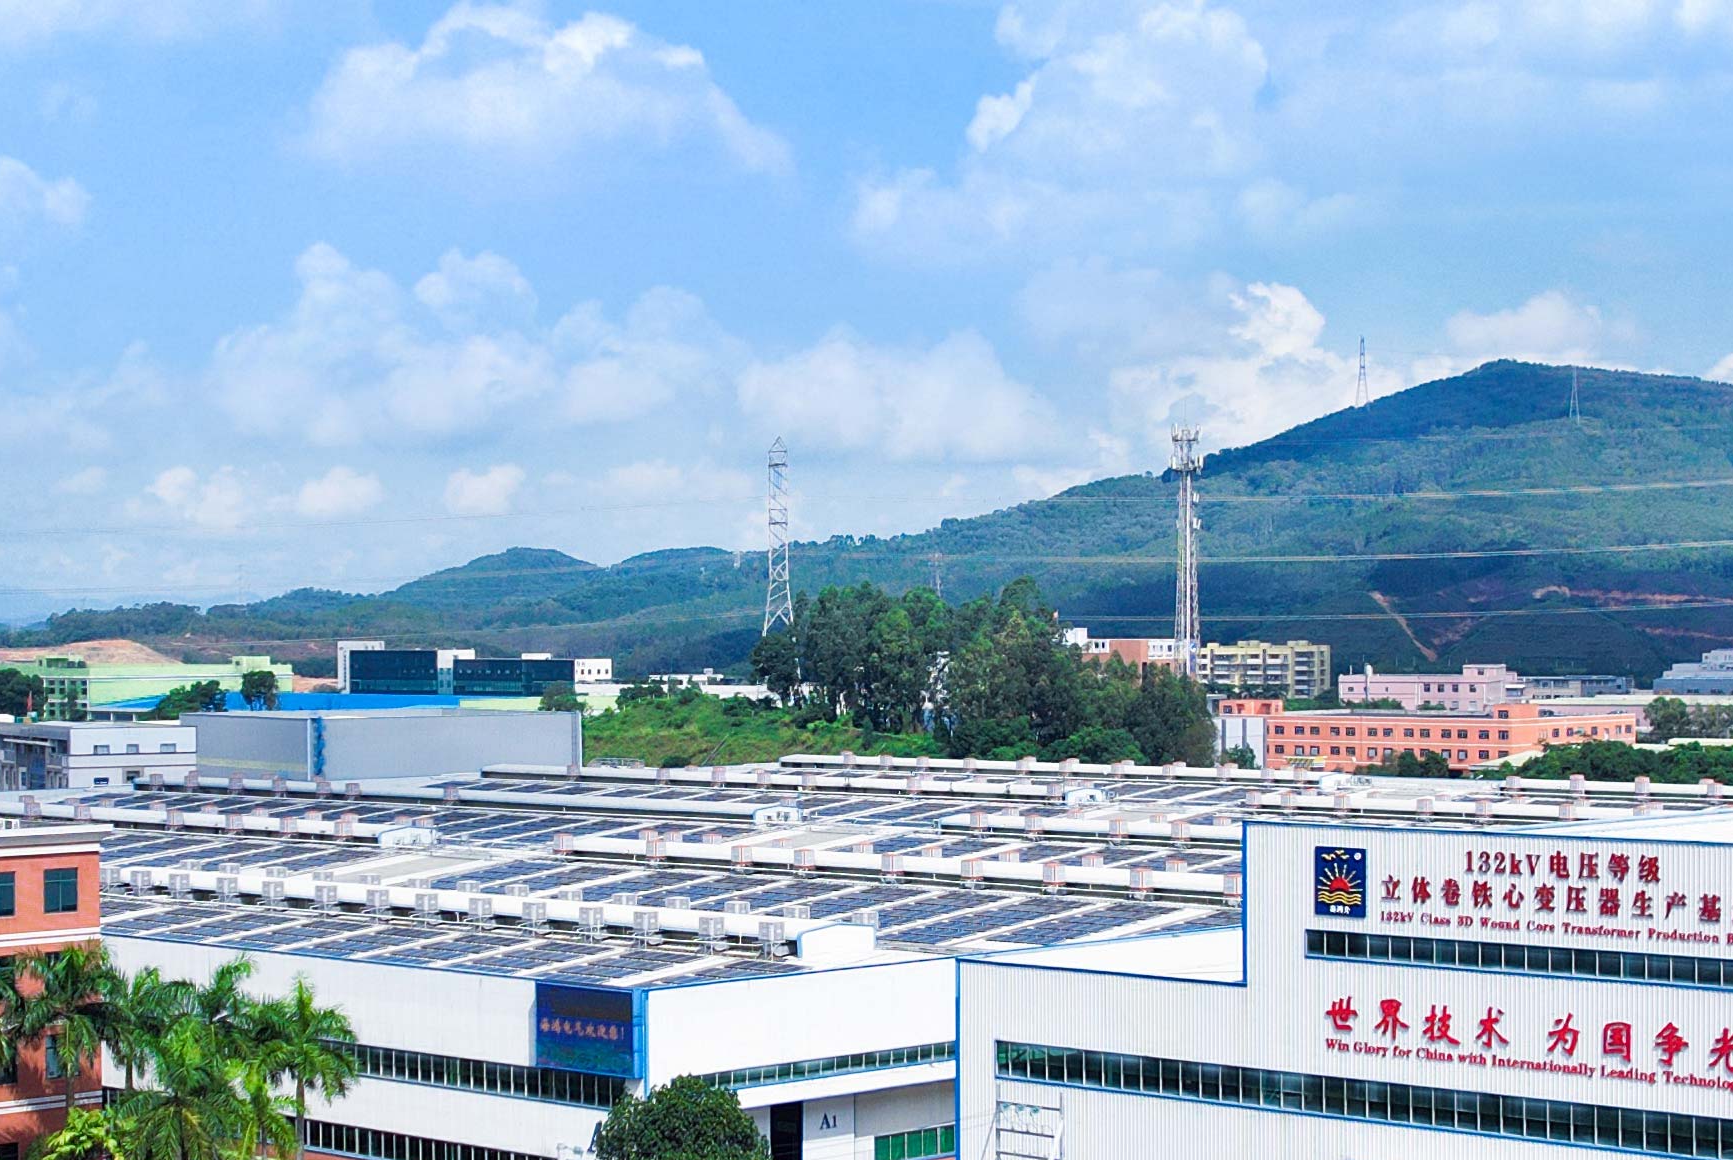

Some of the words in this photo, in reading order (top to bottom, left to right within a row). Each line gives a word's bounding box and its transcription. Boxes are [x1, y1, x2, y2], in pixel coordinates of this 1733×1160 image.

[1465, 850, 1661, 883] 132kV电压等级
[1380, 910, 1414, 922] 132kV
[1420, 913, 1451, 927] Class
[1457, 915, 1473, 927] 3D
[1480, 917, 1520, 930] Wound
[1527, 921, 1555, 932] Core
[1562, 922, 1642, 939] Transformer
[1648, 927, 1719, 944] Production
[1325, 996, 1509, 1048] 世界技术
[1326, 1038, 1349, 1051] Win
[1353, 1042, 1388, 1057] Glory
[1393, 1046, 1412, 1058] for
[1416, 1048, 1454, 1062] China
[1458, 1052, 1487, 1066] with
[1491, 1055, 1596, 1078] Internationally
[1600, 1065, 1657, 1084] Leading
[819, 1113, 837, 1130] A1
